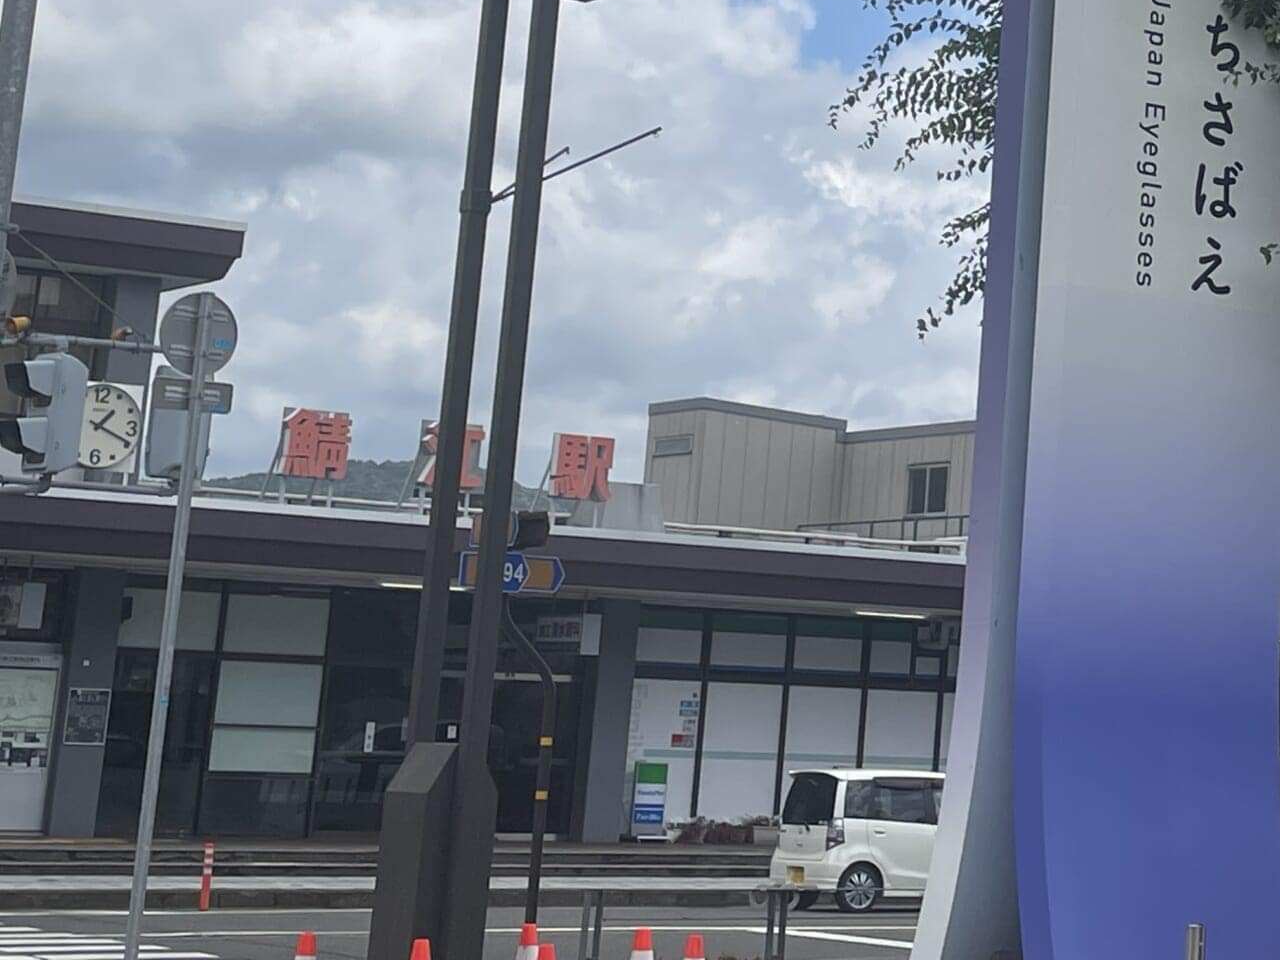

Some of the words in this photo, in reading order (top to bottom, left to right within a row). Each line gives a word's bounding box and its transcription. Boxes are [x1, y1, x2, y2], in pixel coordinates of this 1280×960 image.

[1136, 103, 1166, 287] Eyeglasses
[94, 387, 111, 404] 12
[125, 420, 138, 437] 3
[89, 448, 101, 465] 6
